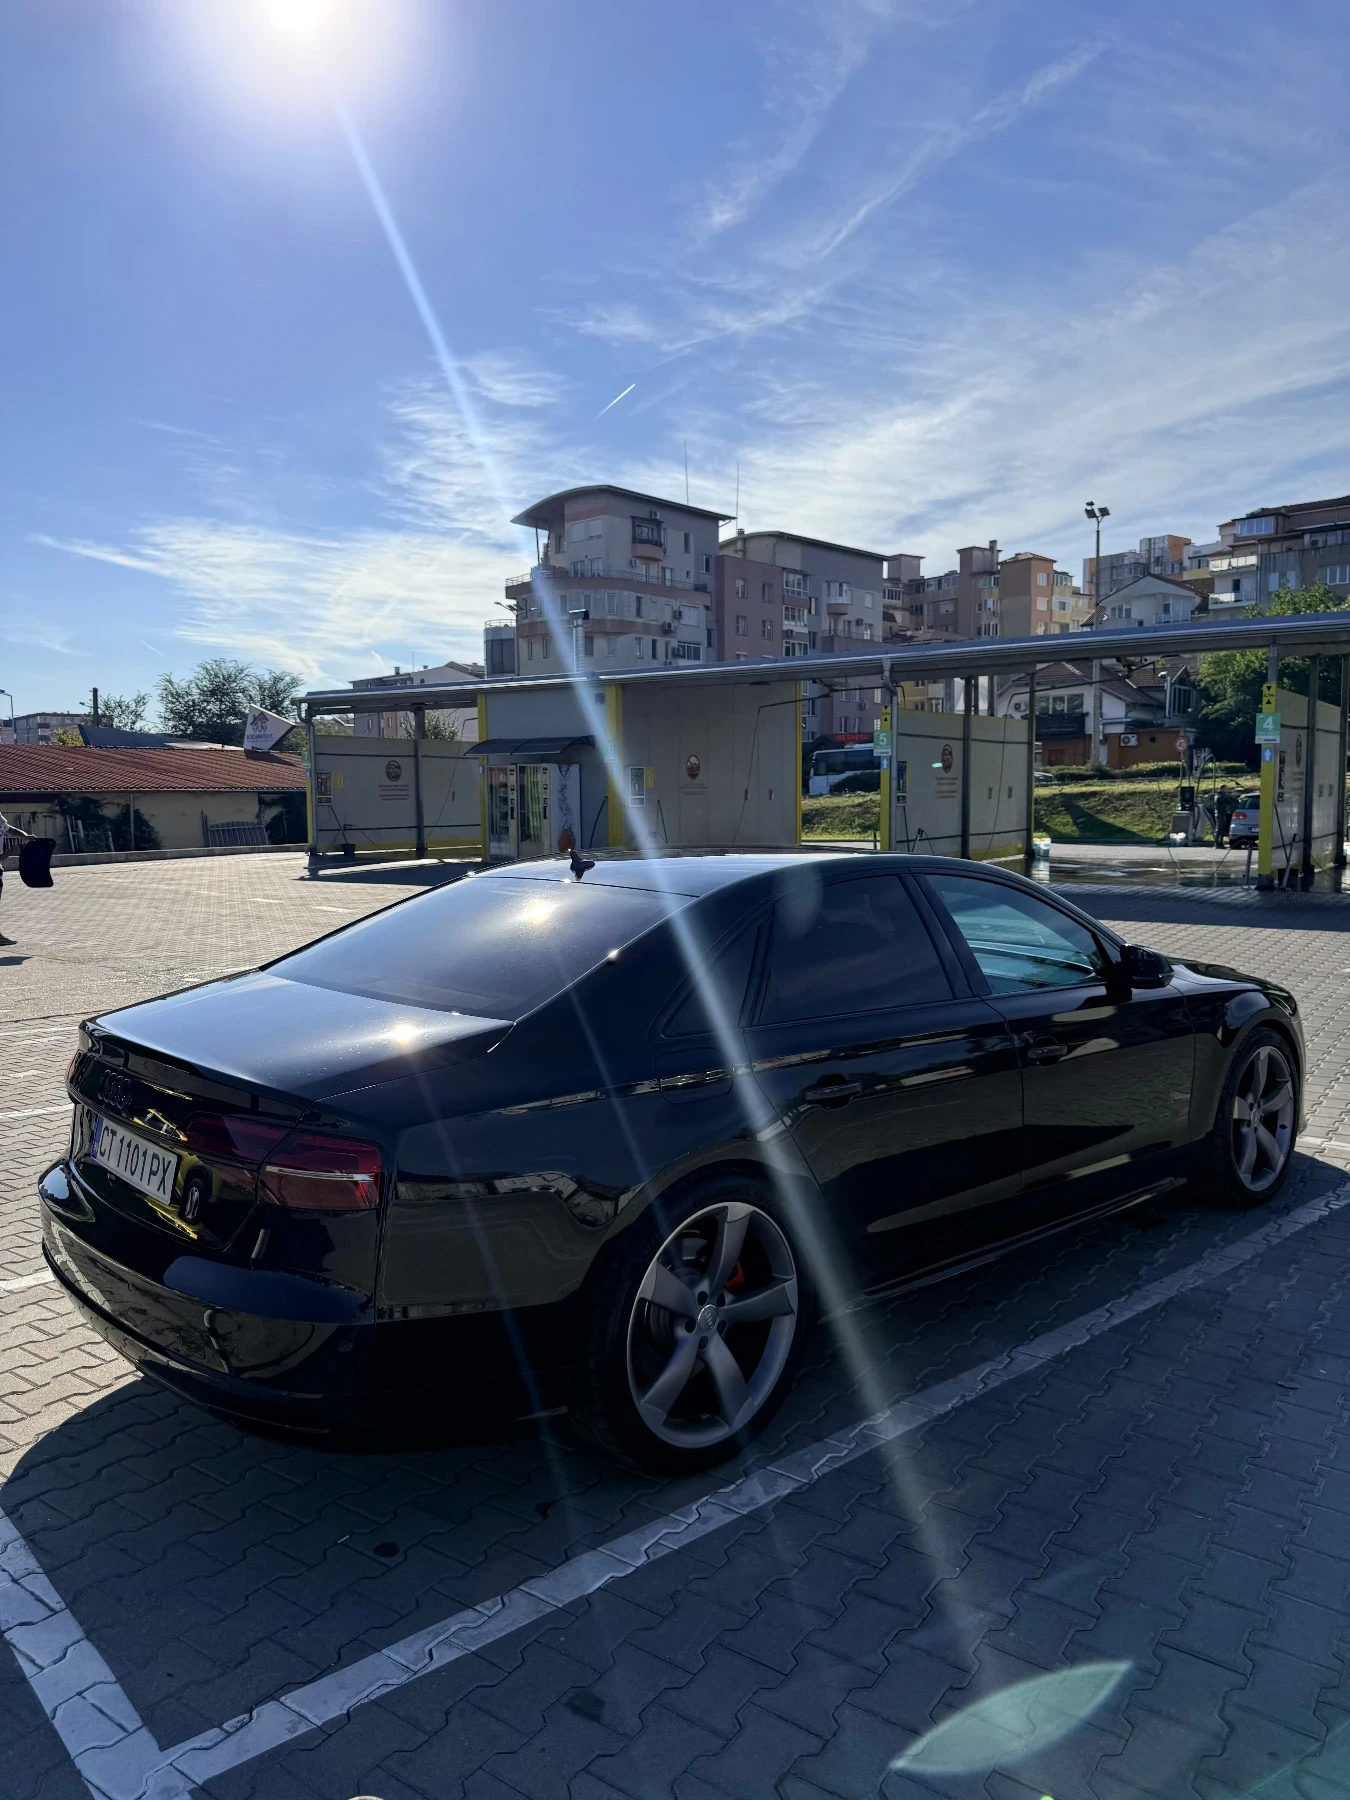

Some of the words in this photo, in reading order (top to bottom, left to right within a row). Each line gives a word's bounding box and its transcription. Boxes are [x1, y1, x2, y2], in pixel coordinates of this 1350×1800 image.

[1262, 715, 1274, 731] 4
[879, 733, 887, 745] 5
[607, 742, 614, 753] 6
[303, 751, 309, 761] 7
